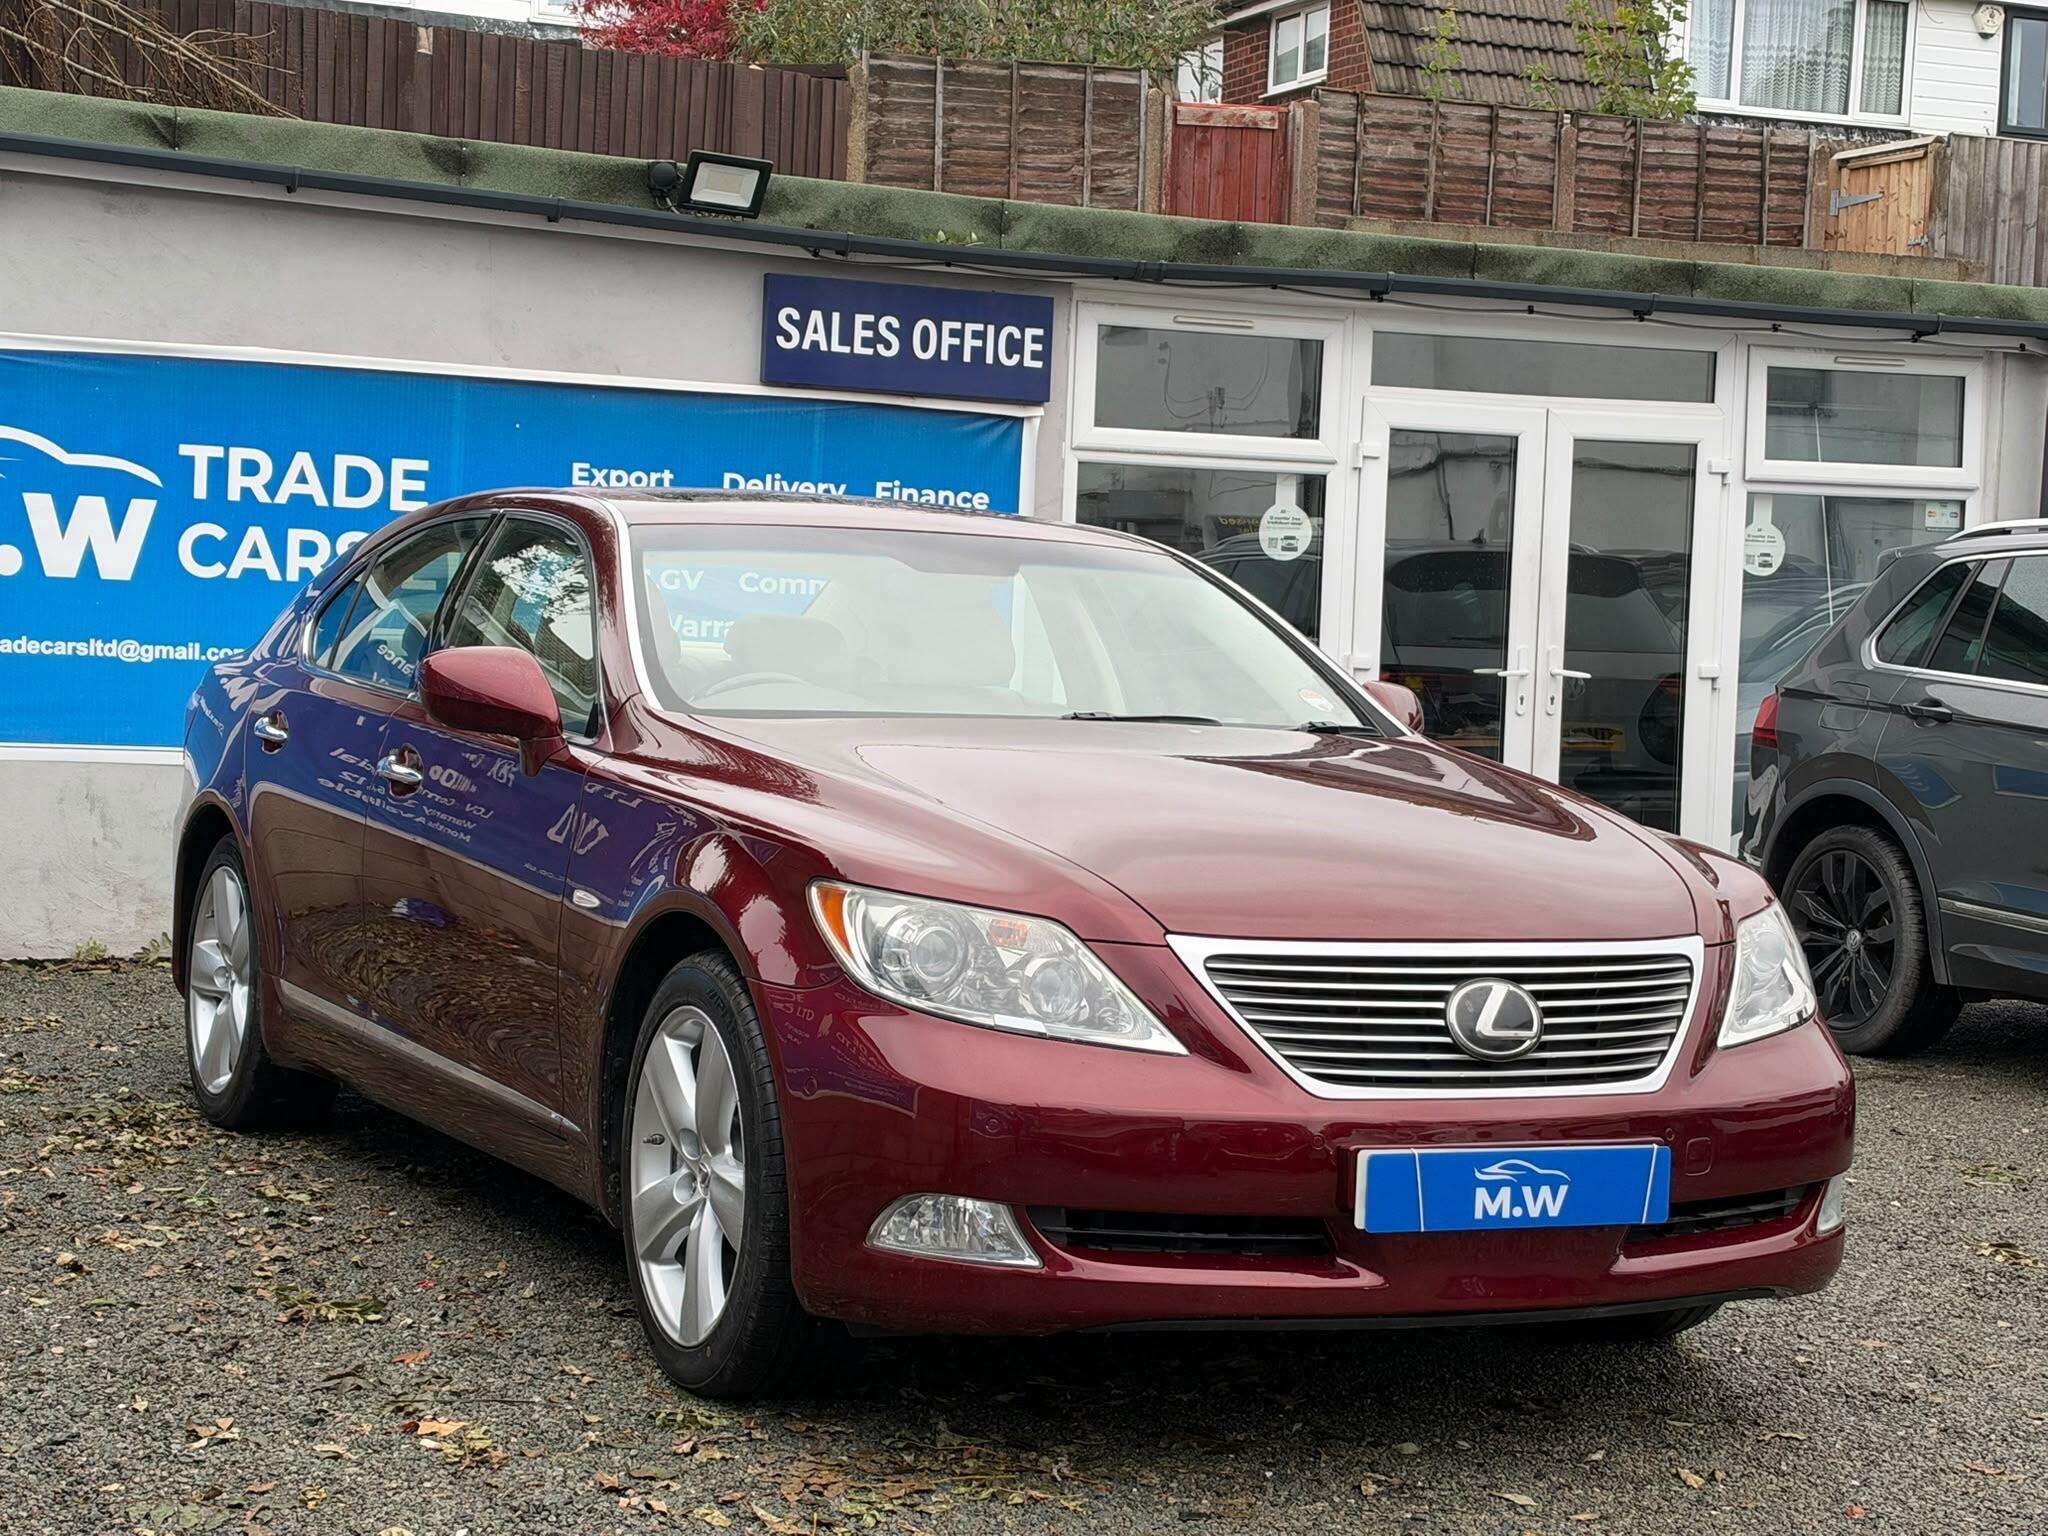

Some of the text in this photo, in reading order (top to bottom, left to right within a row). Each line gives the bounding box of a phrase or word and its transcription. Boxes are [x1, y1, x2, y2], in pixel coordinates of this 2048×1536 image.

[776, 306, 1044, 368] SALES OFFICE
[178, 443, 430, 511] TRADE
[571, 462, 674, 488] Export
[722, 472, 847, 496] Delivery
[875, 481, 990, 509] Finance
[1473, 1184, 1569, 1220] M.W
